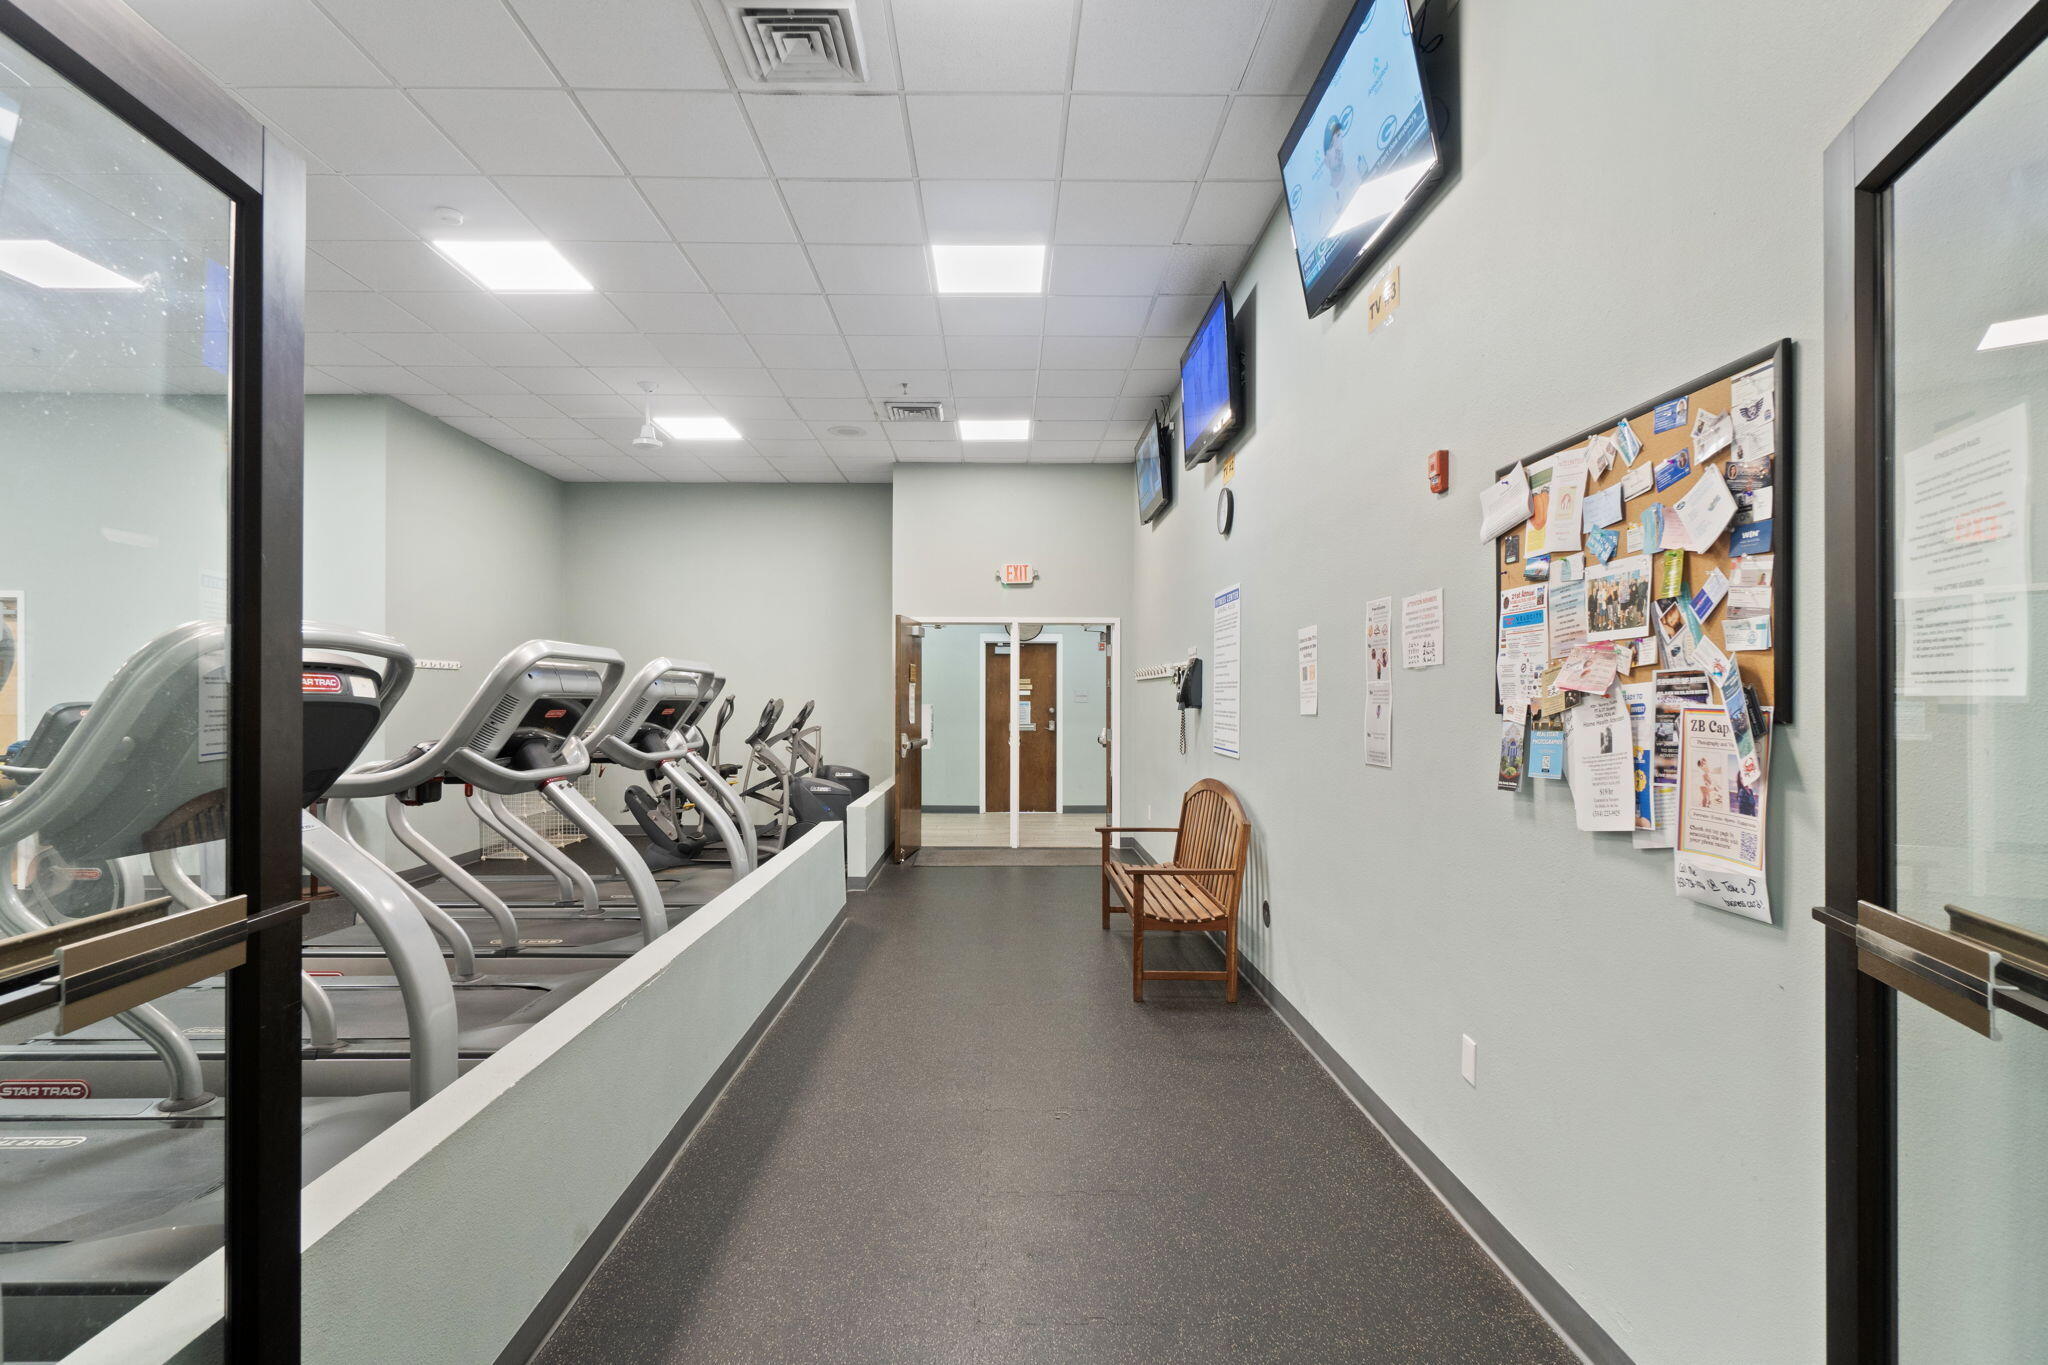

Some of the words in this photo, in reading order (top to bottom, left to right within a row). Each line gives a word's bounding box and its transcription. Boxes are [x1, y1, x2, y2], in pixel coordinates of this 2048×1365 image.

[1369, 296, 1381, 320] TV
[1006, 564, 1029, 583] EXIT
[1516, 612, 1543, 622] VELOCITY
[302, 678, 313, 686] AR
[314, 678, 337, 686] TRAC
[1691, 719, 1706, 733] ZB
[1709, 722, 1730, 738] Cap
[1, 1086, 40, 1096] STAR
[41, 1086, 82, 1096] TRAC
